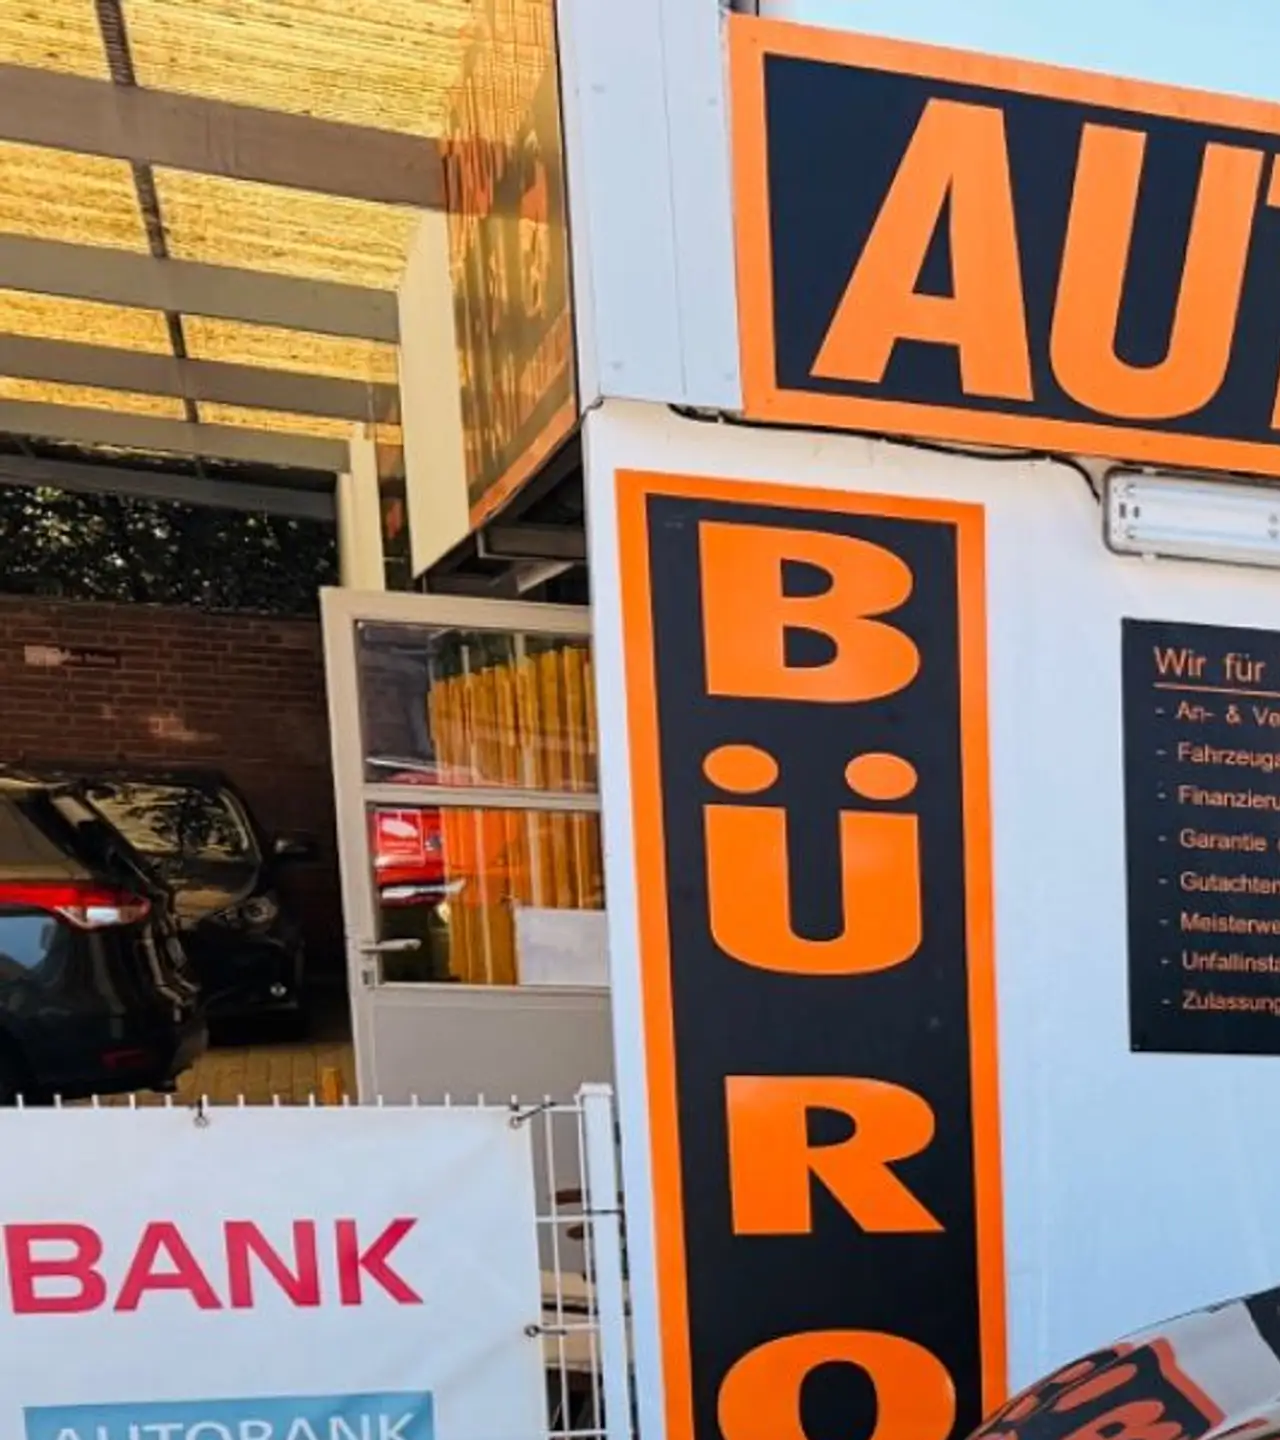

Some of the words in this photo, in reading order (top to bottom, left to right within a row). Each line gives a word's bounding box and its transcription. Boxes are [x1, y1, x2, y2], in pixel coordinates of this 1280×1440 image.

[1154, 646, 1207, 677] Wir
[1225, 652, 1266, 683] für
[1225, 705, 1242, 725] &
[1179, 828, 1268, 852] Garantie
[4, 1217, 424, 1314] BANK
